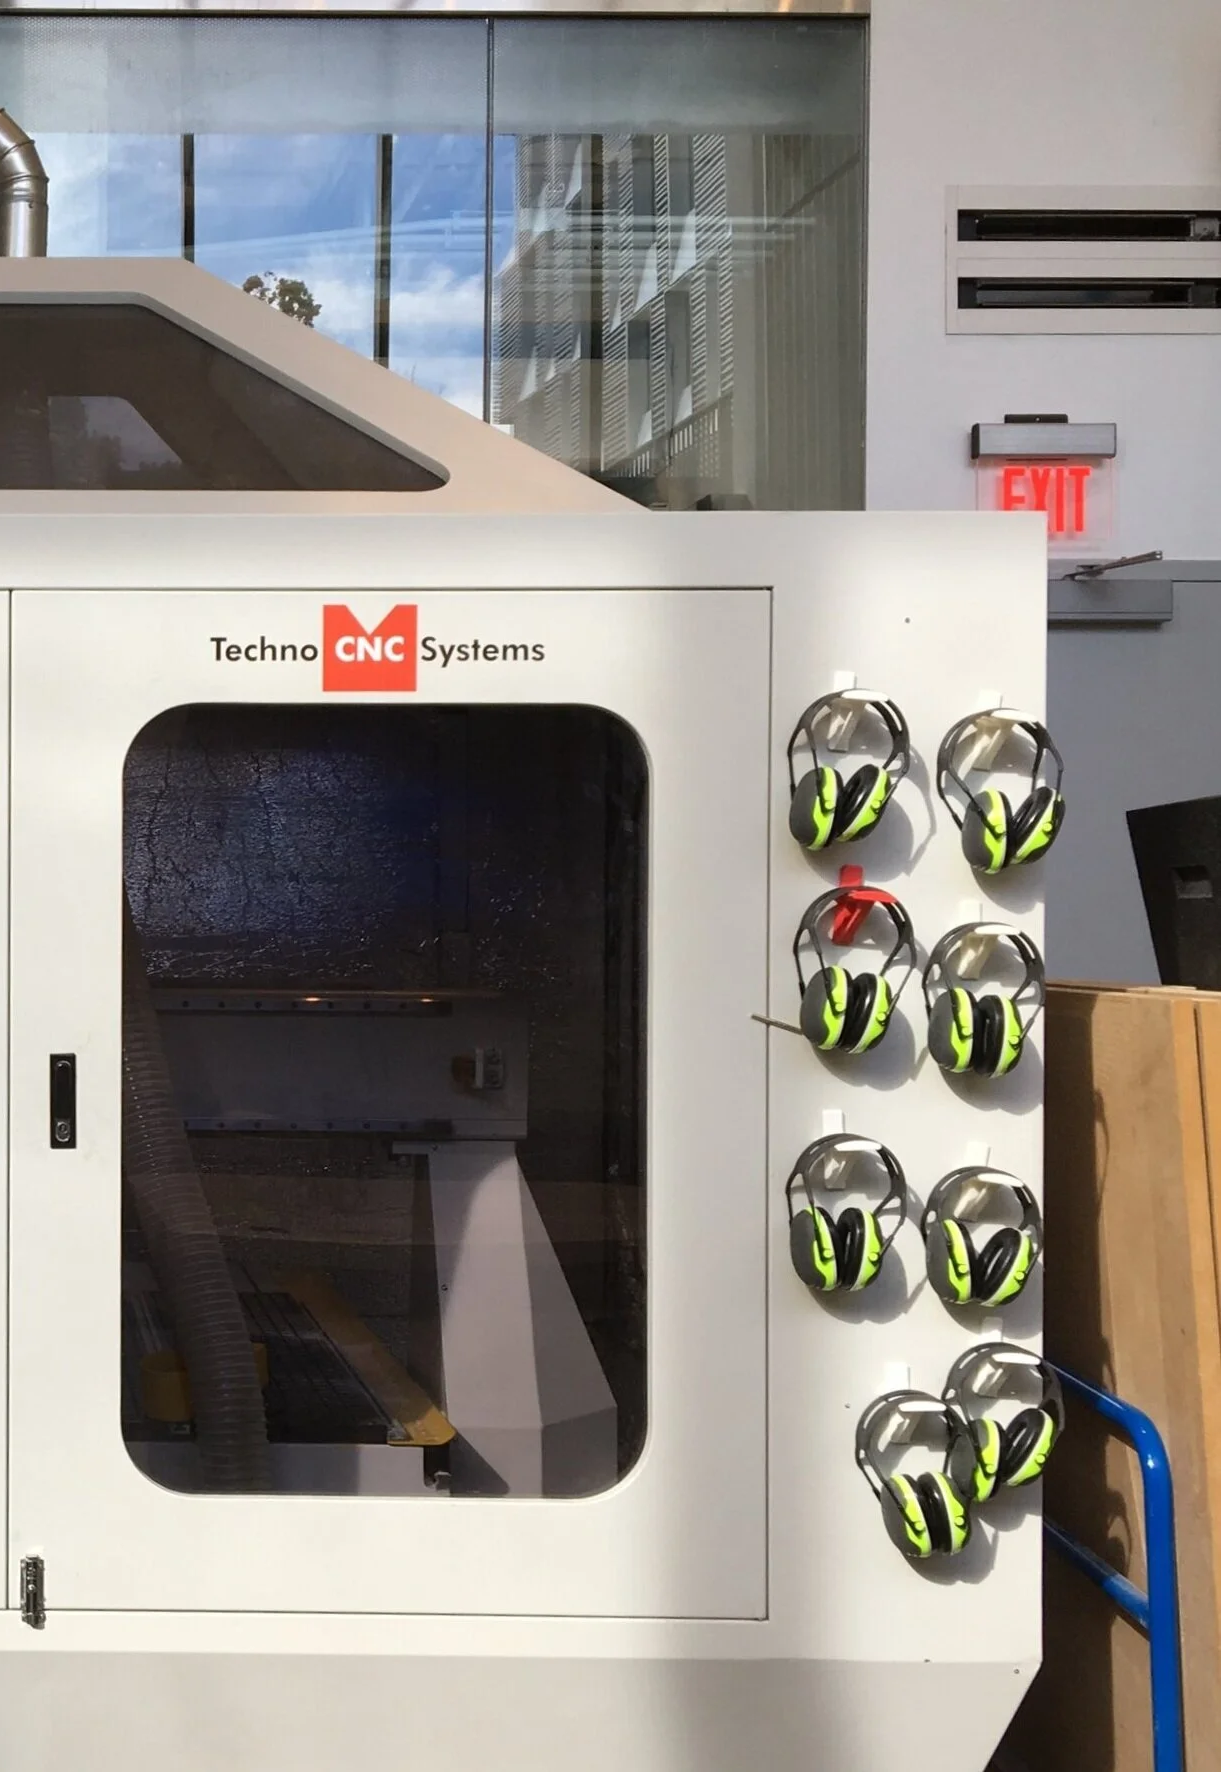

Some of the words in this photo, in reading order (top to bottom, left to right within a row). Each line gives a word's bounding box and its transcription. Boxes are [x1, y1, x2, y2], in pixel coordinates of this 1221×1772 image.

[1003, 467, 1091, 532] EXIT
[210, 635, 319, 662] Techno
[334, 635, 405, 663] CNC
[421, 636, 546, 668] Systems
